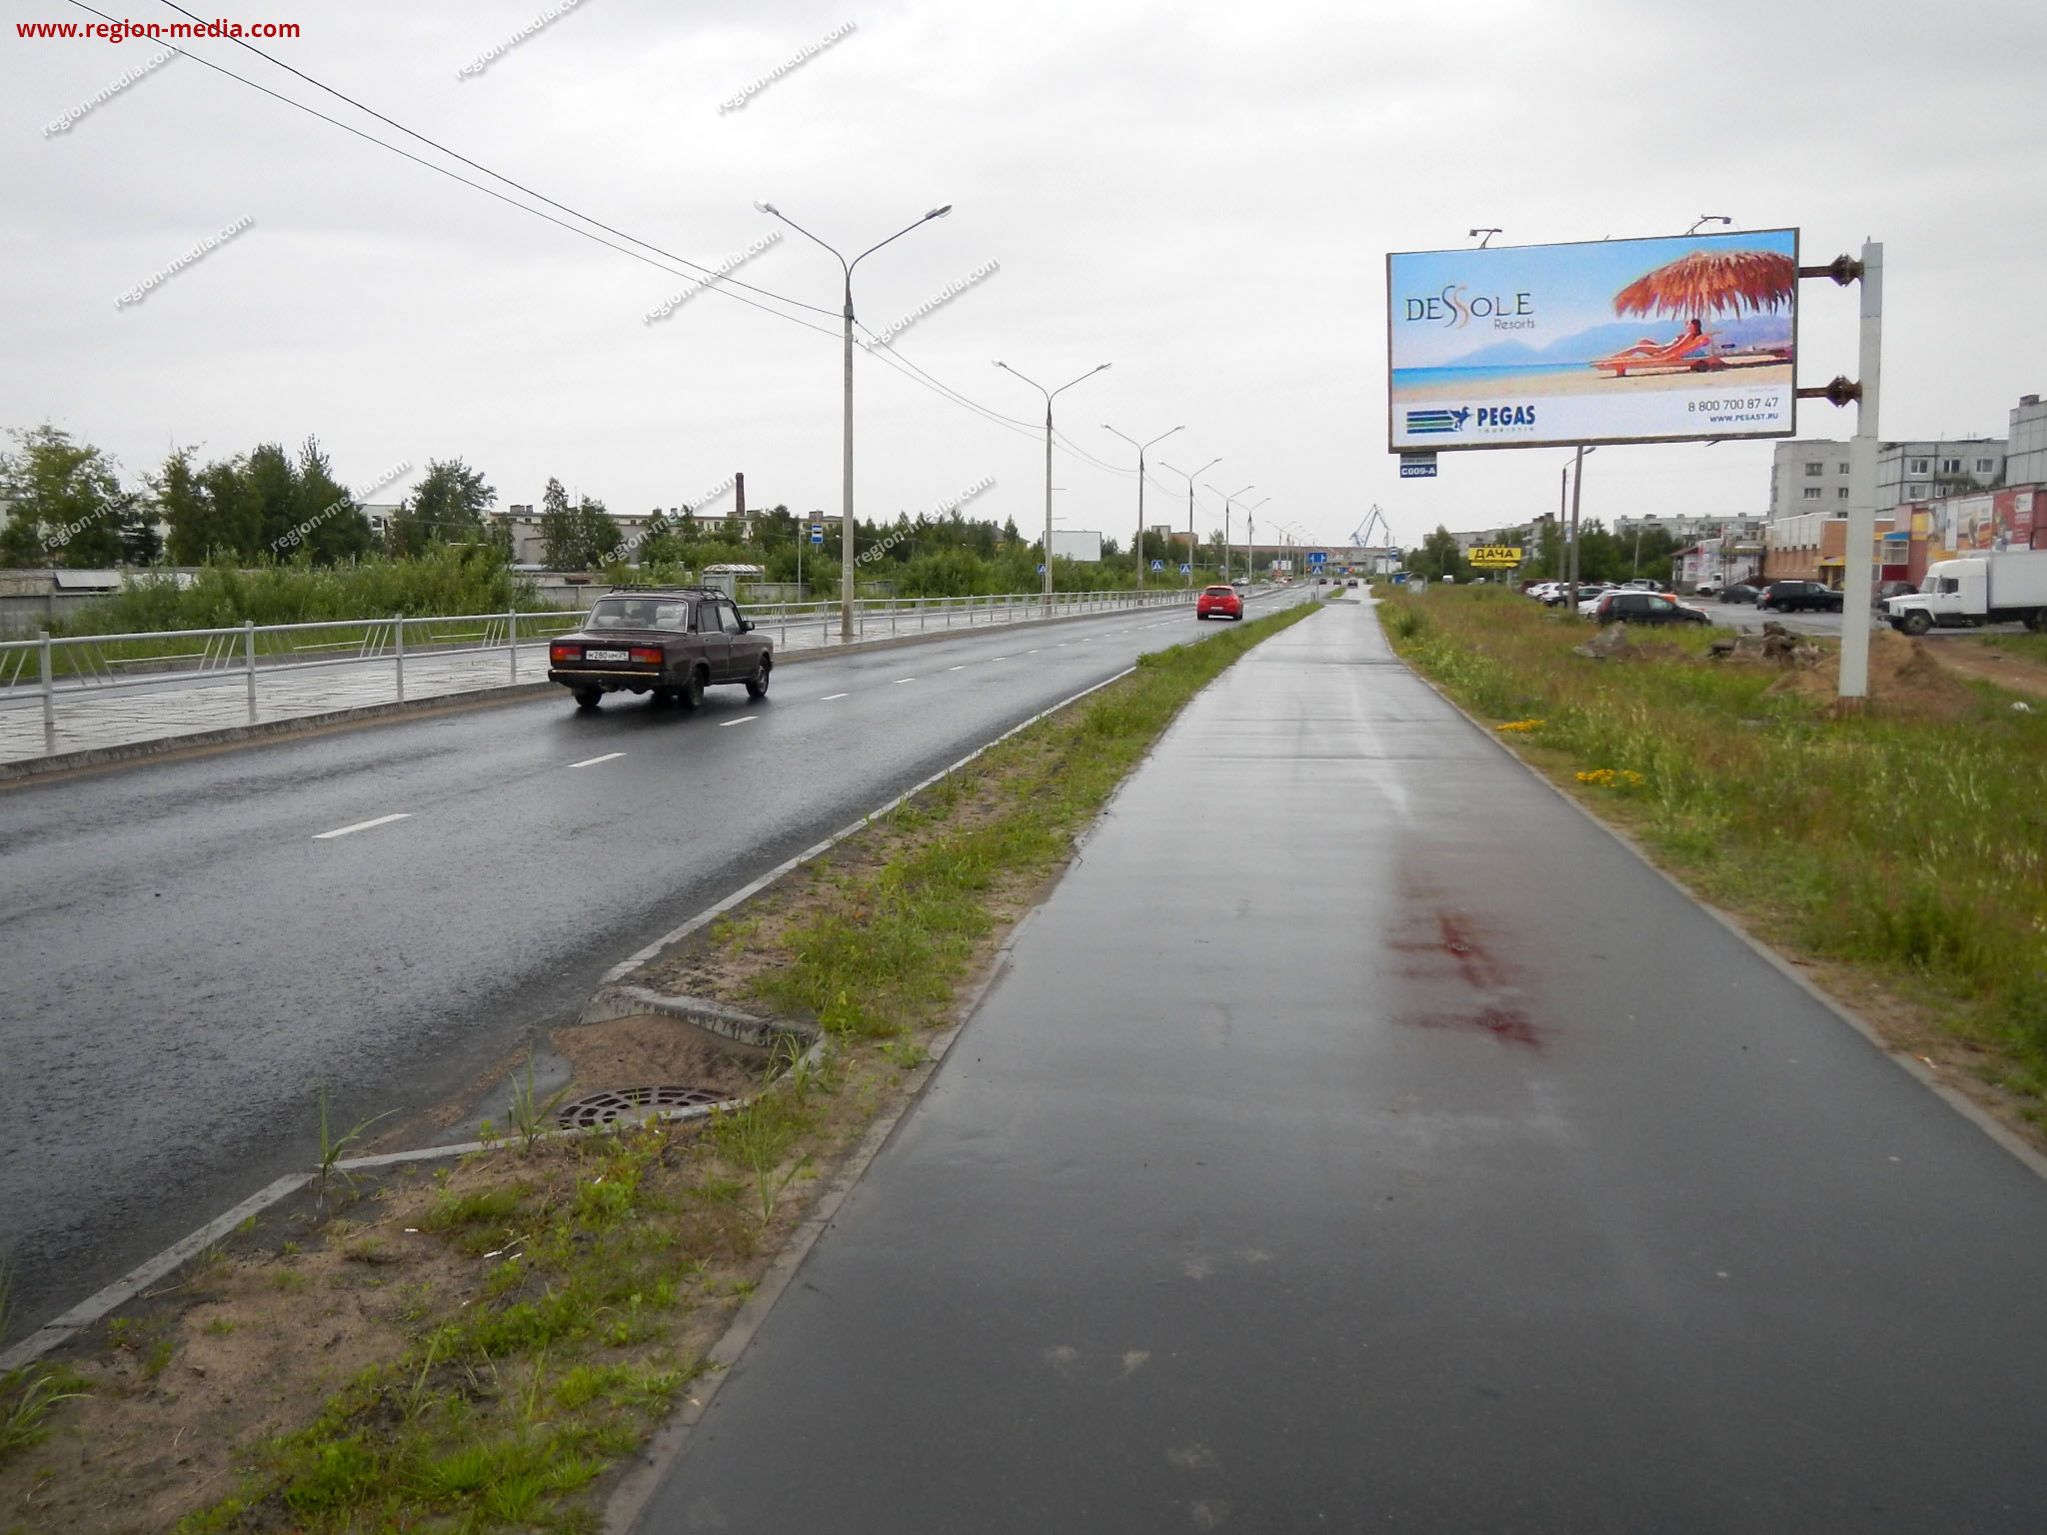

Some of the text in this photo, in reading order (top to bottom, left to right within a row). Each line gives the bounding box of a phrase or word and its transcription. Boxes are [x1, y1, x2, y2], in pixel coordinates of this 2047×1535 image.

[1406, 284, 1534, 329] DESSOLE
[1494, 319, 1535, 330] Resorts
[1688, 397, 1779, 412] 8 800 700 87 47
[1477, 405, 1536, 427] PEGAS
[1475, 549, 1514, 560] ДАЧА
